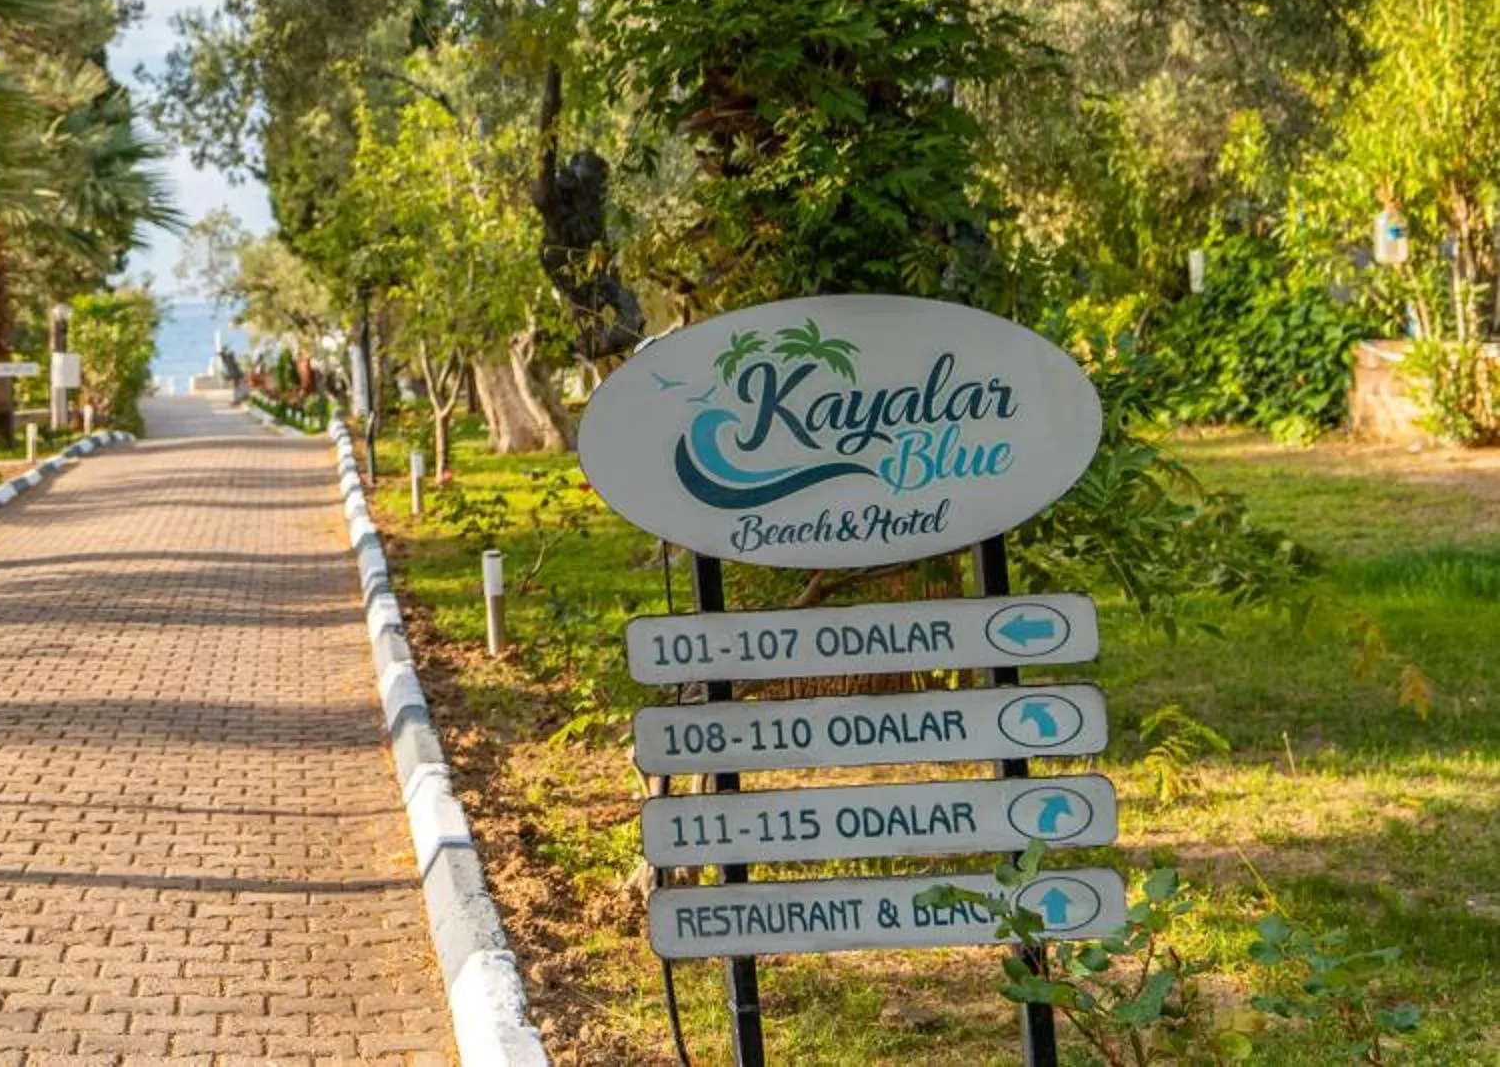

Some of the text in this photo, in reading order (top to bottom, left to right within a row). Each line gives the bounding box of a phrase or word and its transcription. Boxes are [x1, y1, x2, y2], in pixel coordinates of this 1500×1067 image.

[734, 353, 1019, 455] Kayalar
[878, 423, 1013, 495] Blue
[730, 499, 950, 553] Beach&Hotel
[652, 619, 956, 667] 101-107 ODALAR
[663, 709, 968, 757] 108-110 ODALAR
[670, 801, 978, 849] 111-115 ODALAR
[675, 899, 864, 939] RESTAURANT
[876, 897, 901, 930] &
